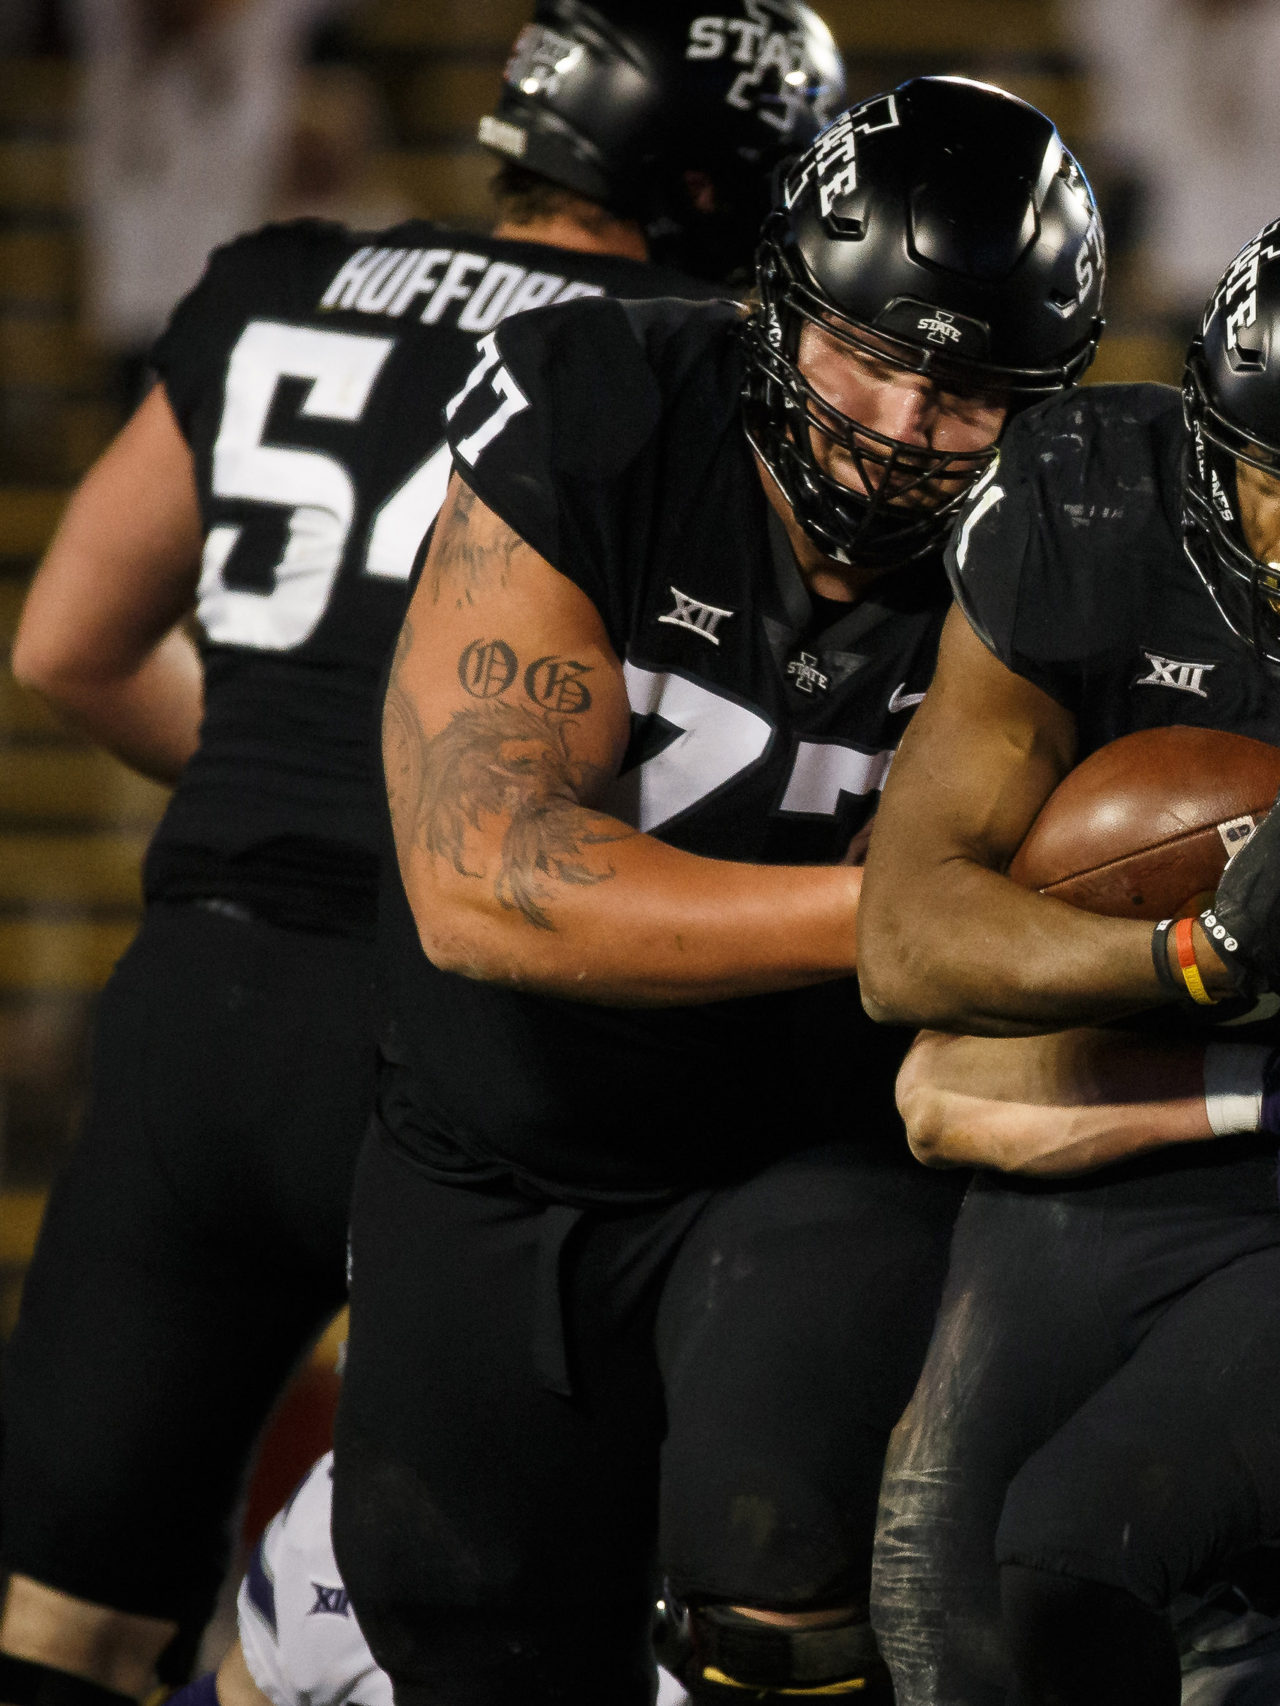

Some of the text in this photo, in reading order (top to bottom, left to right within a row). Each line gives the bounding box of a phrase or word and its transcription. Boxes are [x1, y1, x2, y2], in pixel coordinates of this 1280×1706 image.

[917, 318, 962, 343] STATE
[657, 586, 734, 646] XII
[787, 661, 828, 690] STATE
[1136, 651, 1216, 698] XII
